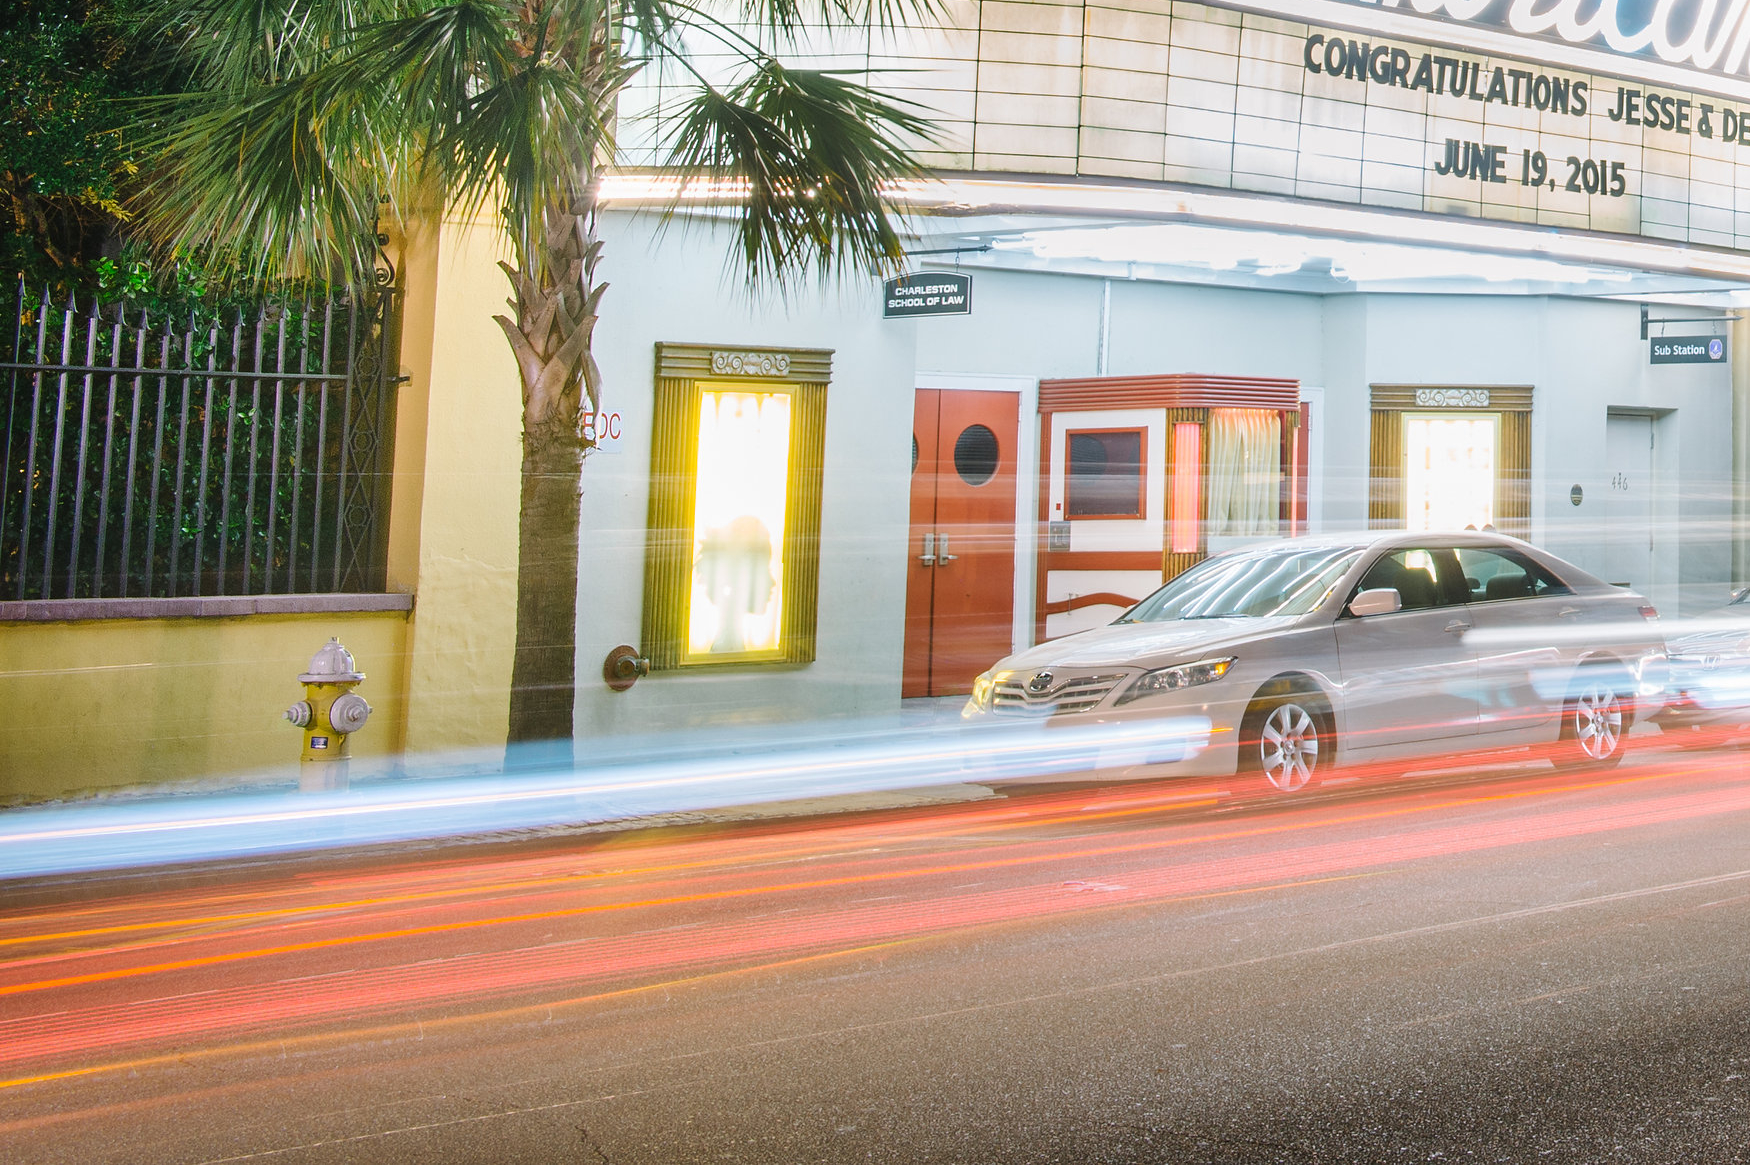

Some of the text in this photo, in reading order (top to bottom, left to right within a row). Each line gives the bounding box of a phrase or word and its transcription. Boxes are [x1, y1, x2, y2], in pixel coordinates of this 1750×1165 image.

[1303, 33, 1588, 117] CONGRATULATIONS
[1607, 86, 1691, 135] JESSE
[1697, 103, 1714, 139] &
[1434, 137, 1626, 198] JUNE 19, 2015
[895, 283, 958, 296] CHARLESTON
[888, 295, 965, 308] SCHOOL OF LAW
[1654, 344, 1705, 356] Sub Station
[1612, 476, 1628, 491] 446
